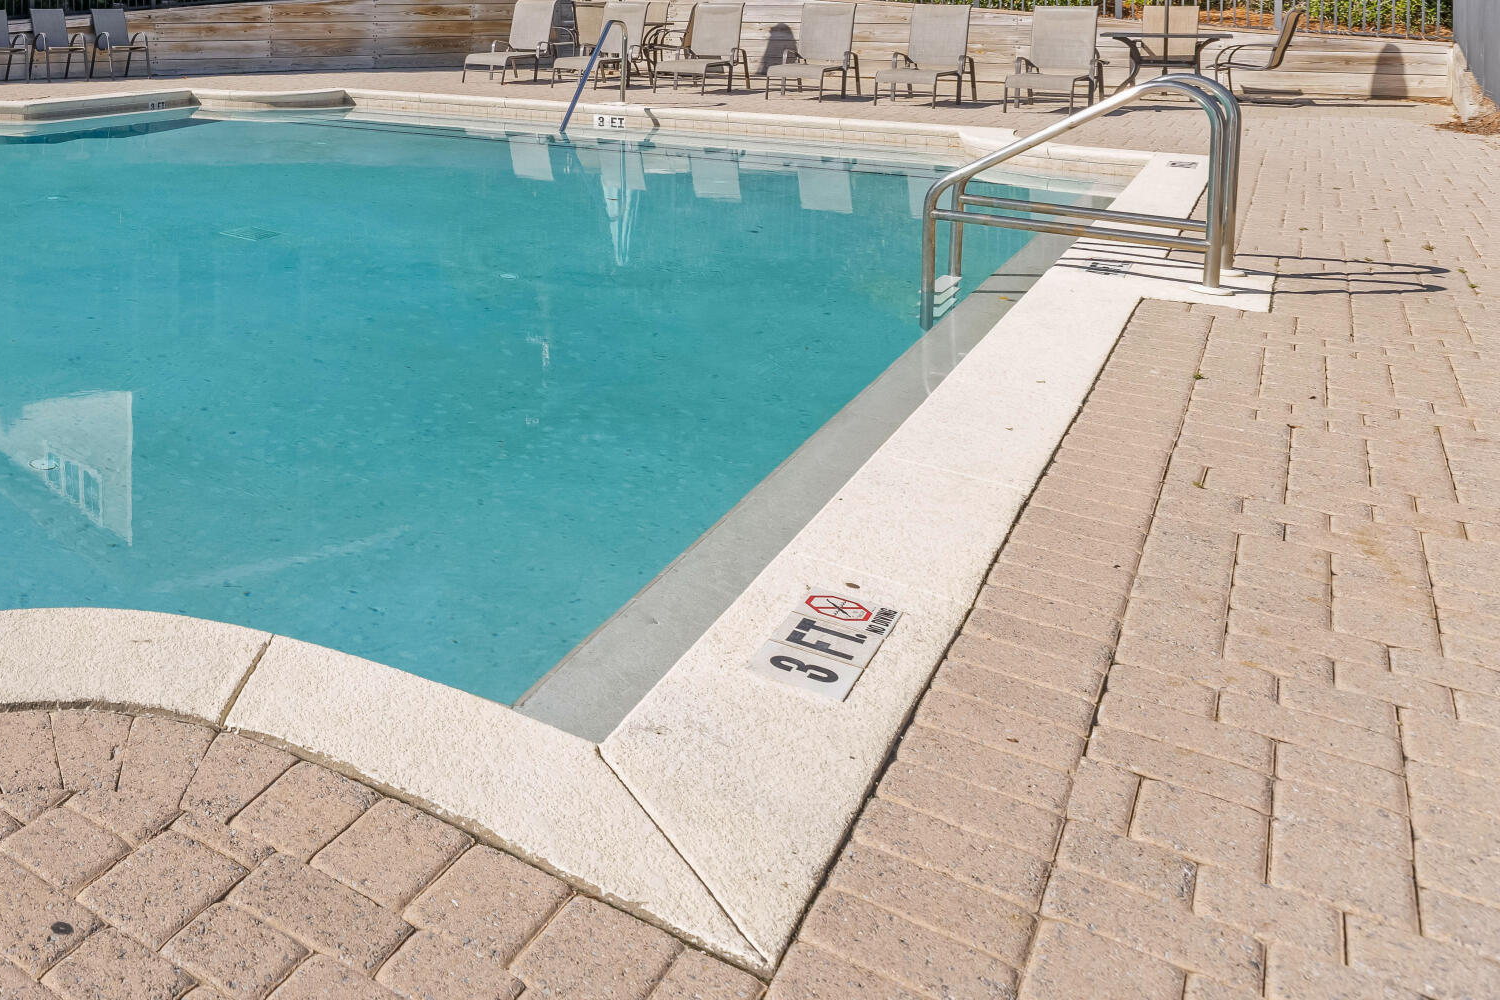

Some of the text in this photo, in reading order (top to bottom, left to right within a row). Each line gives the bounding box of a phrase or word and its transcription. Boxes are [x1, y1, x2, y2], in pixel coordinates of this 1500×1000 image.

[865, 607, 898, 636] NO DIVING
[769, 655, 839, 683] 3
